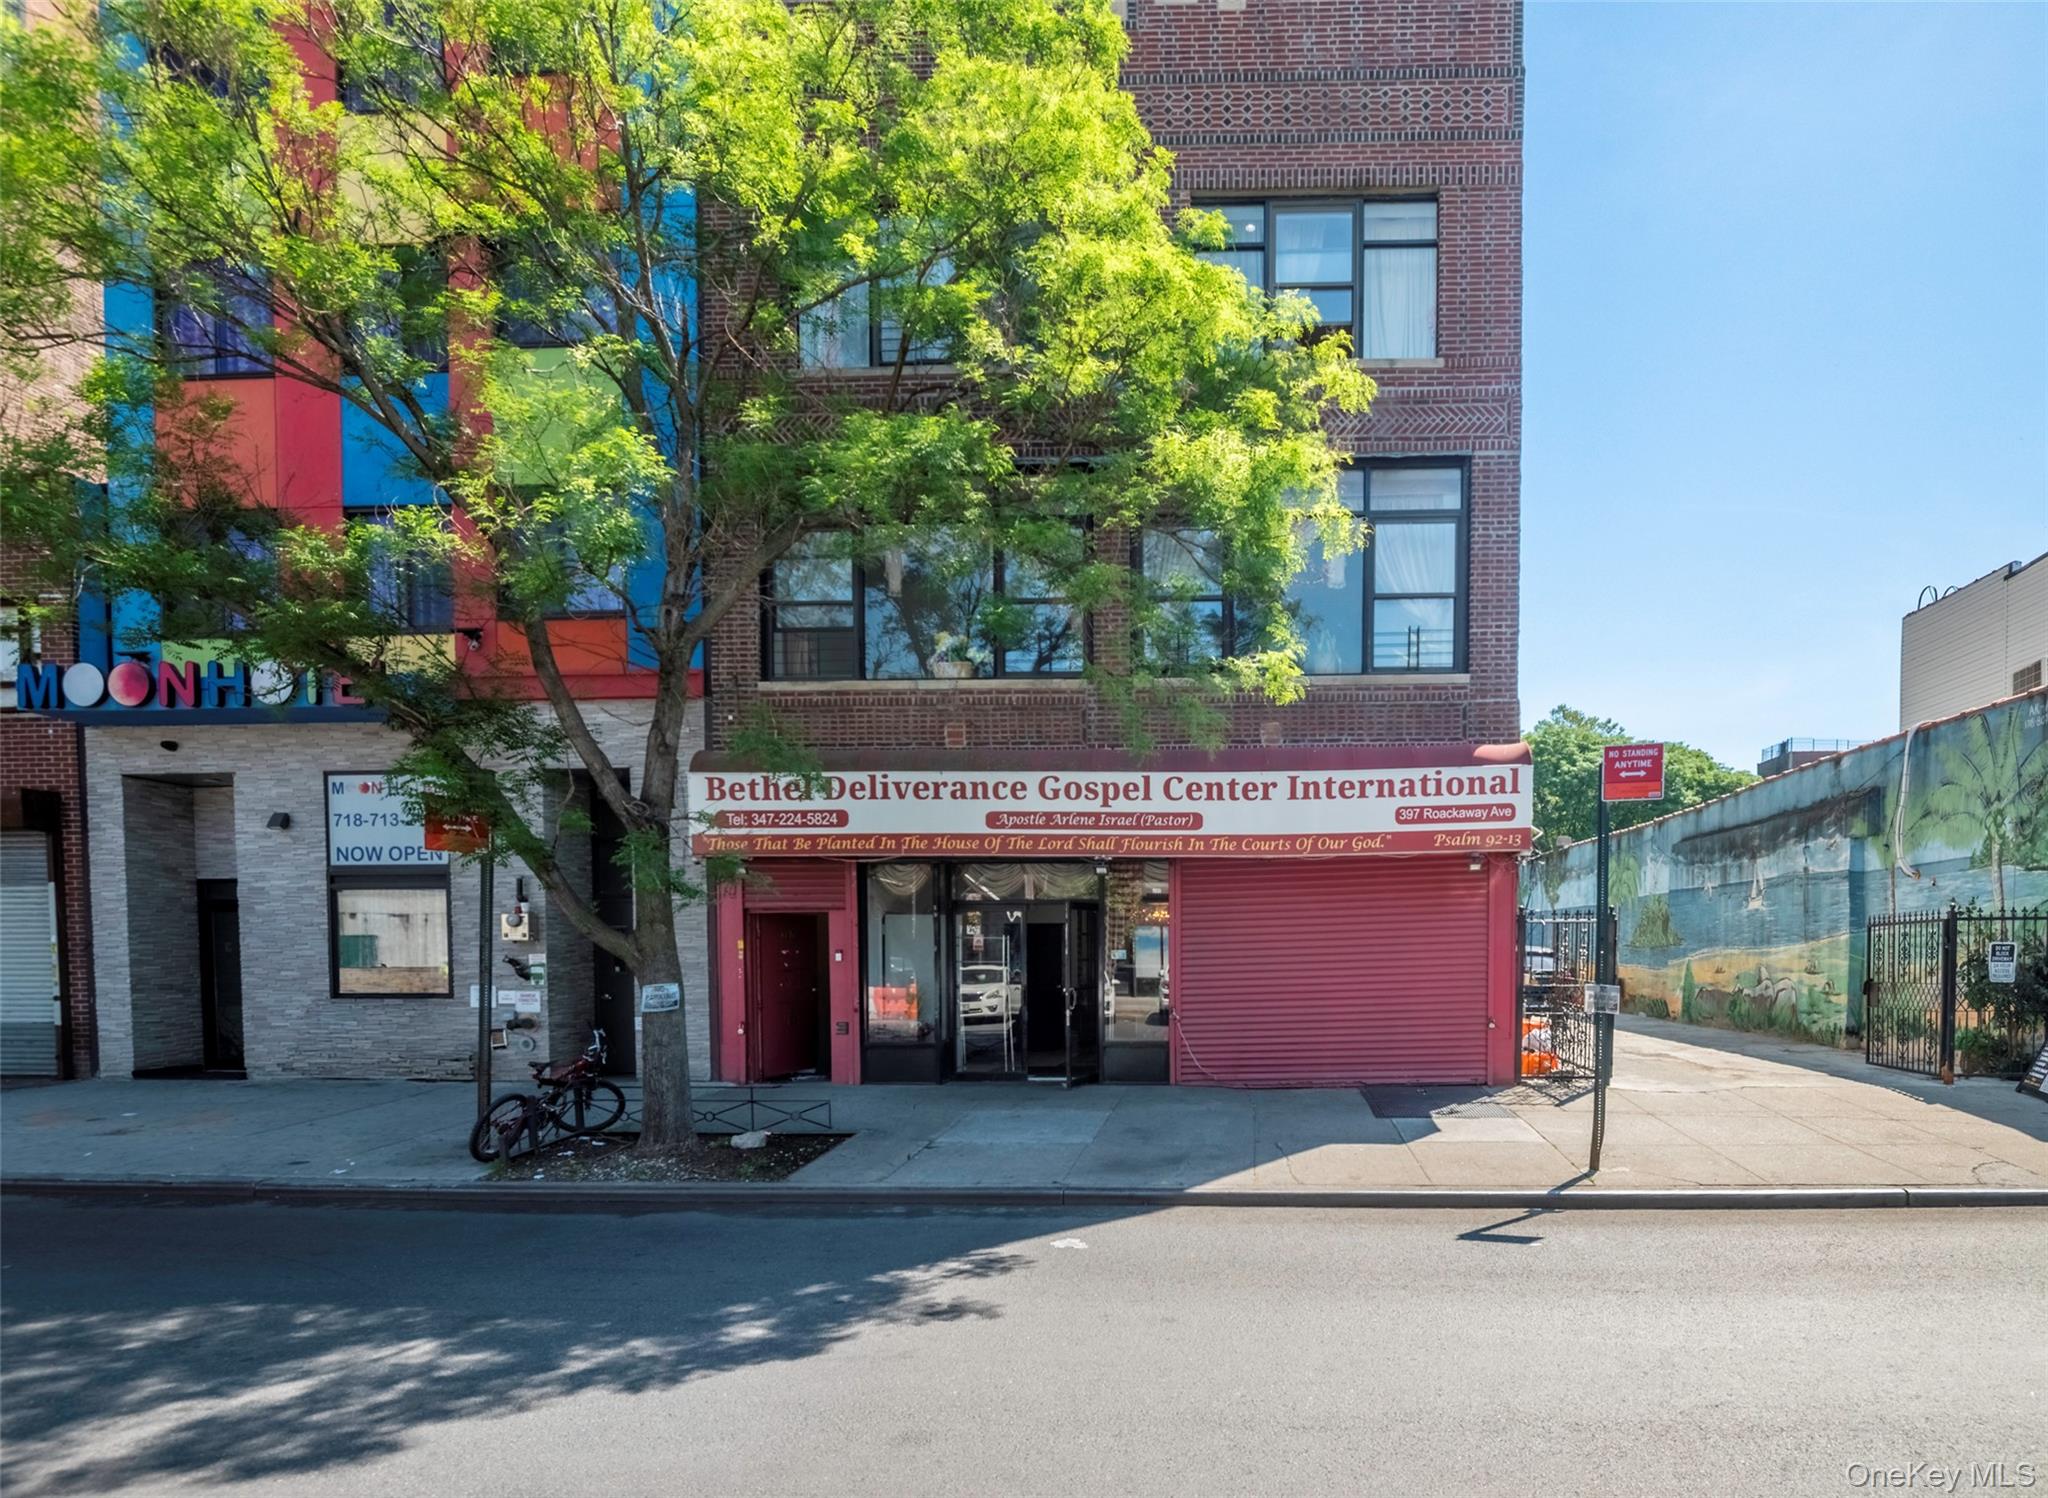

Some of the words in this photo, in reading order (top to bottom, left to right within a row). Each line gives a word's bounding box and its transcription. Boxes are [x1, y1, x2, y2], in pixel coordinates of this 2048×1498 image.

[1608, 750, 1619, 758] NO
[1622, 748, 1658, 757] STANDING
[1614, 760, 1653, 768] ANYTIME
[704, 775, 812, 801] Bethel
[823, 774, 1028, 801] Deliverance
[1038, 775, 1152, 807] Gospel
[1162, 776, 1278, 801] Center
[1286, 768, 1521, 800] International
[726, 813, 747, 826] Tel:
[751, 812, 838, 826] 347-224-5824
[996, 813, 1046, 829] Apostle
[1049, 813, 1095, 826] Arlene
[1098, 812, 1138, 826] Israel
[1140, 813, 1194, 828] (Pastor)
[1399, 808, 1420, 820] 397
[1423, 806, 1488, 822] Roackaway
[1489, 806, 1512, 818] Ave
[752, 836, 787, 850] That
[793, 836, 812, 850] Be
[816, 835, 876, 850] Planted
[879, 836, 896, 849] In
[901, 836, 928, 850] The
[932, 835, 979, 850] House
[984, 836, 1002, 854] Of
[1005, 836, 1033, 850] The
[1037, 835, 1077, 850] Lord
[1078, 835, 1115, 850] Shall
[1120, 836, 1183, 853] Flourish
[1187, 837, 1204, 850] In
[1208, 836, 1237, 850] The
[1241, 837, 1291, 850] Courts
[1295, 836, 1315, 854] Of
[1317, 837, 1348, 849] Our
[1433, 831, 1481, 847] Psalm
[1485, 833, 1522, 847] 92-13
[336, 846, 383, 862] NOW
[388, 846, 443, 862] OPEN
